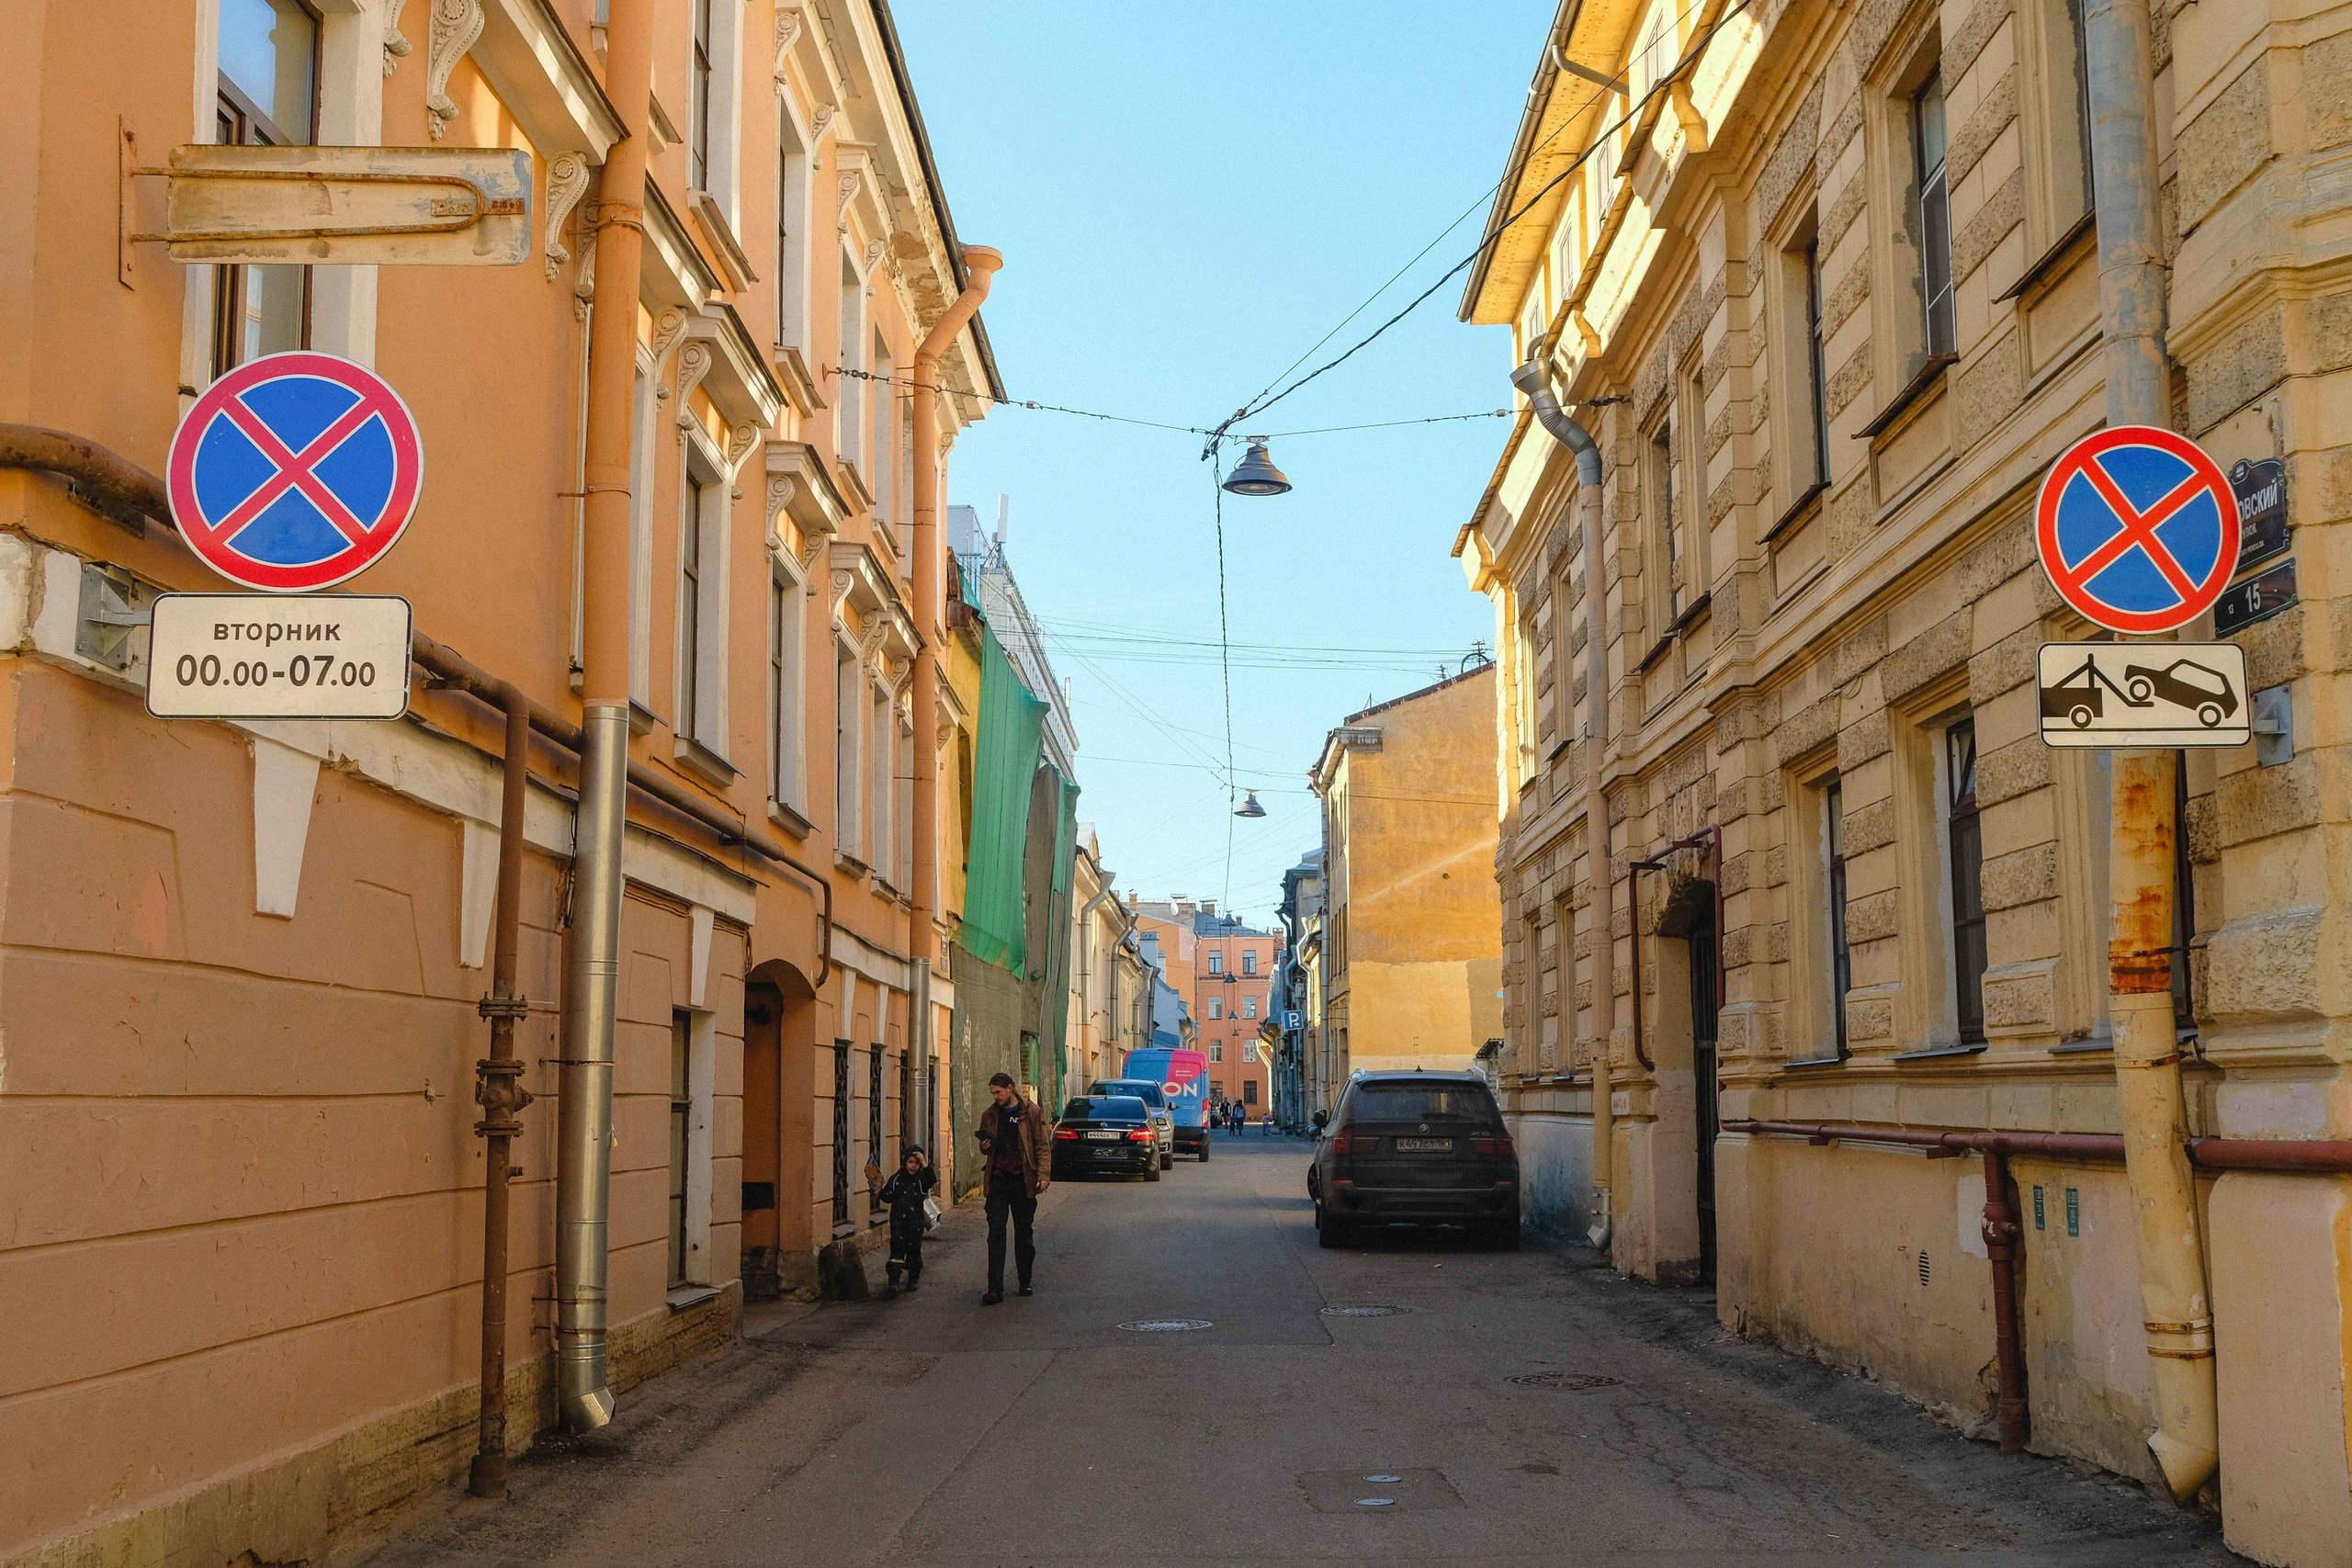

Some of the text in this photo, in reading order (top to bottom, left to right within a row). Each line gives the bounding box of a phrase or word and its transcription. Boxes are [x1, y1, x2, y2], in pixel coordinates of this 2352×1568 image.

[2245, 582, 2261, 613] 15
[213, 623, 341, 647] вторник
[175, 654, 376, 687] 00.00-07.00
[1289, 1012, 1299, 1028] P
[1159, 1081, 1198, 1098] ON
